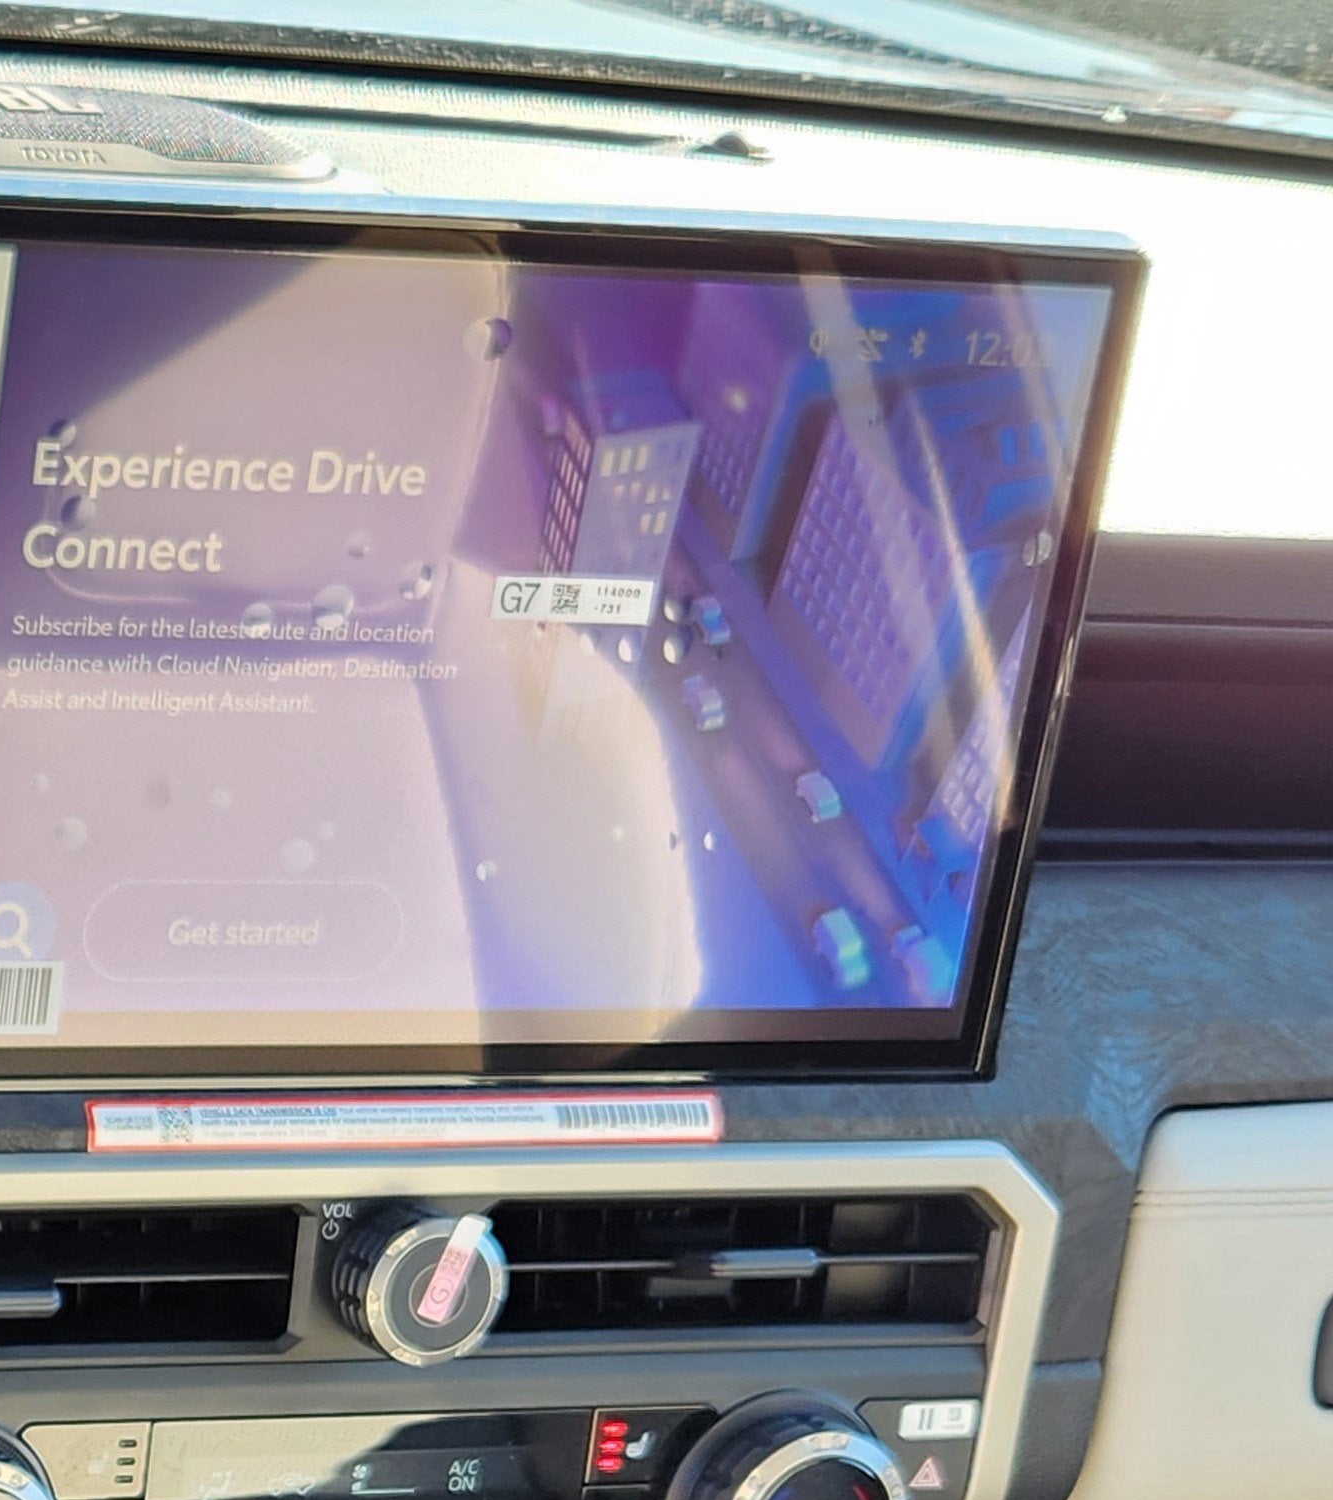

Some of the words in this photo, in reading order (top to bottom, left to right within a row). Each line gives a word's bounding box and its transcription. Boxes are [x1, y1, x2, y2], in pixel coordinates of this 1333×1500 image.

[20, 148, 107, 164] TOYOTA
[965, 331, 1049, 366] 12:0
[32, 443, 295, 498] Experience
[306, 450, 427, 497] Drive
[22, 524, 223, 572] Connect
[500, 582, 541, 613] G7
[12, 614, 113, 637] Subscribe
[118, 617, 150, 637] for
[151, 617, 185, 638] the
[189, 618, 245, 641] latest
[310, 622, 349, 642] and
[354, 622, 434, 643] location
[7, 652, 104, 678] guidance
[108, 654, 152, 674] with
[157, 655, 219, 675] Cloud
[225, 656, 336, 682] Navigation,
[343, 658, 457, 680] Destination
[1, 689, 62, 710] Assist
[67, 690, 107, 710] and
[112, 690, 215, 716] Intelligent
[168, 918, 222, 947] Get
[226, 918, 322, 947] started
[322, 1203, 353, 1219] VOL
[448, 1458, 480, 1476] A/C
[448, 1476, 476, 1492] ON
